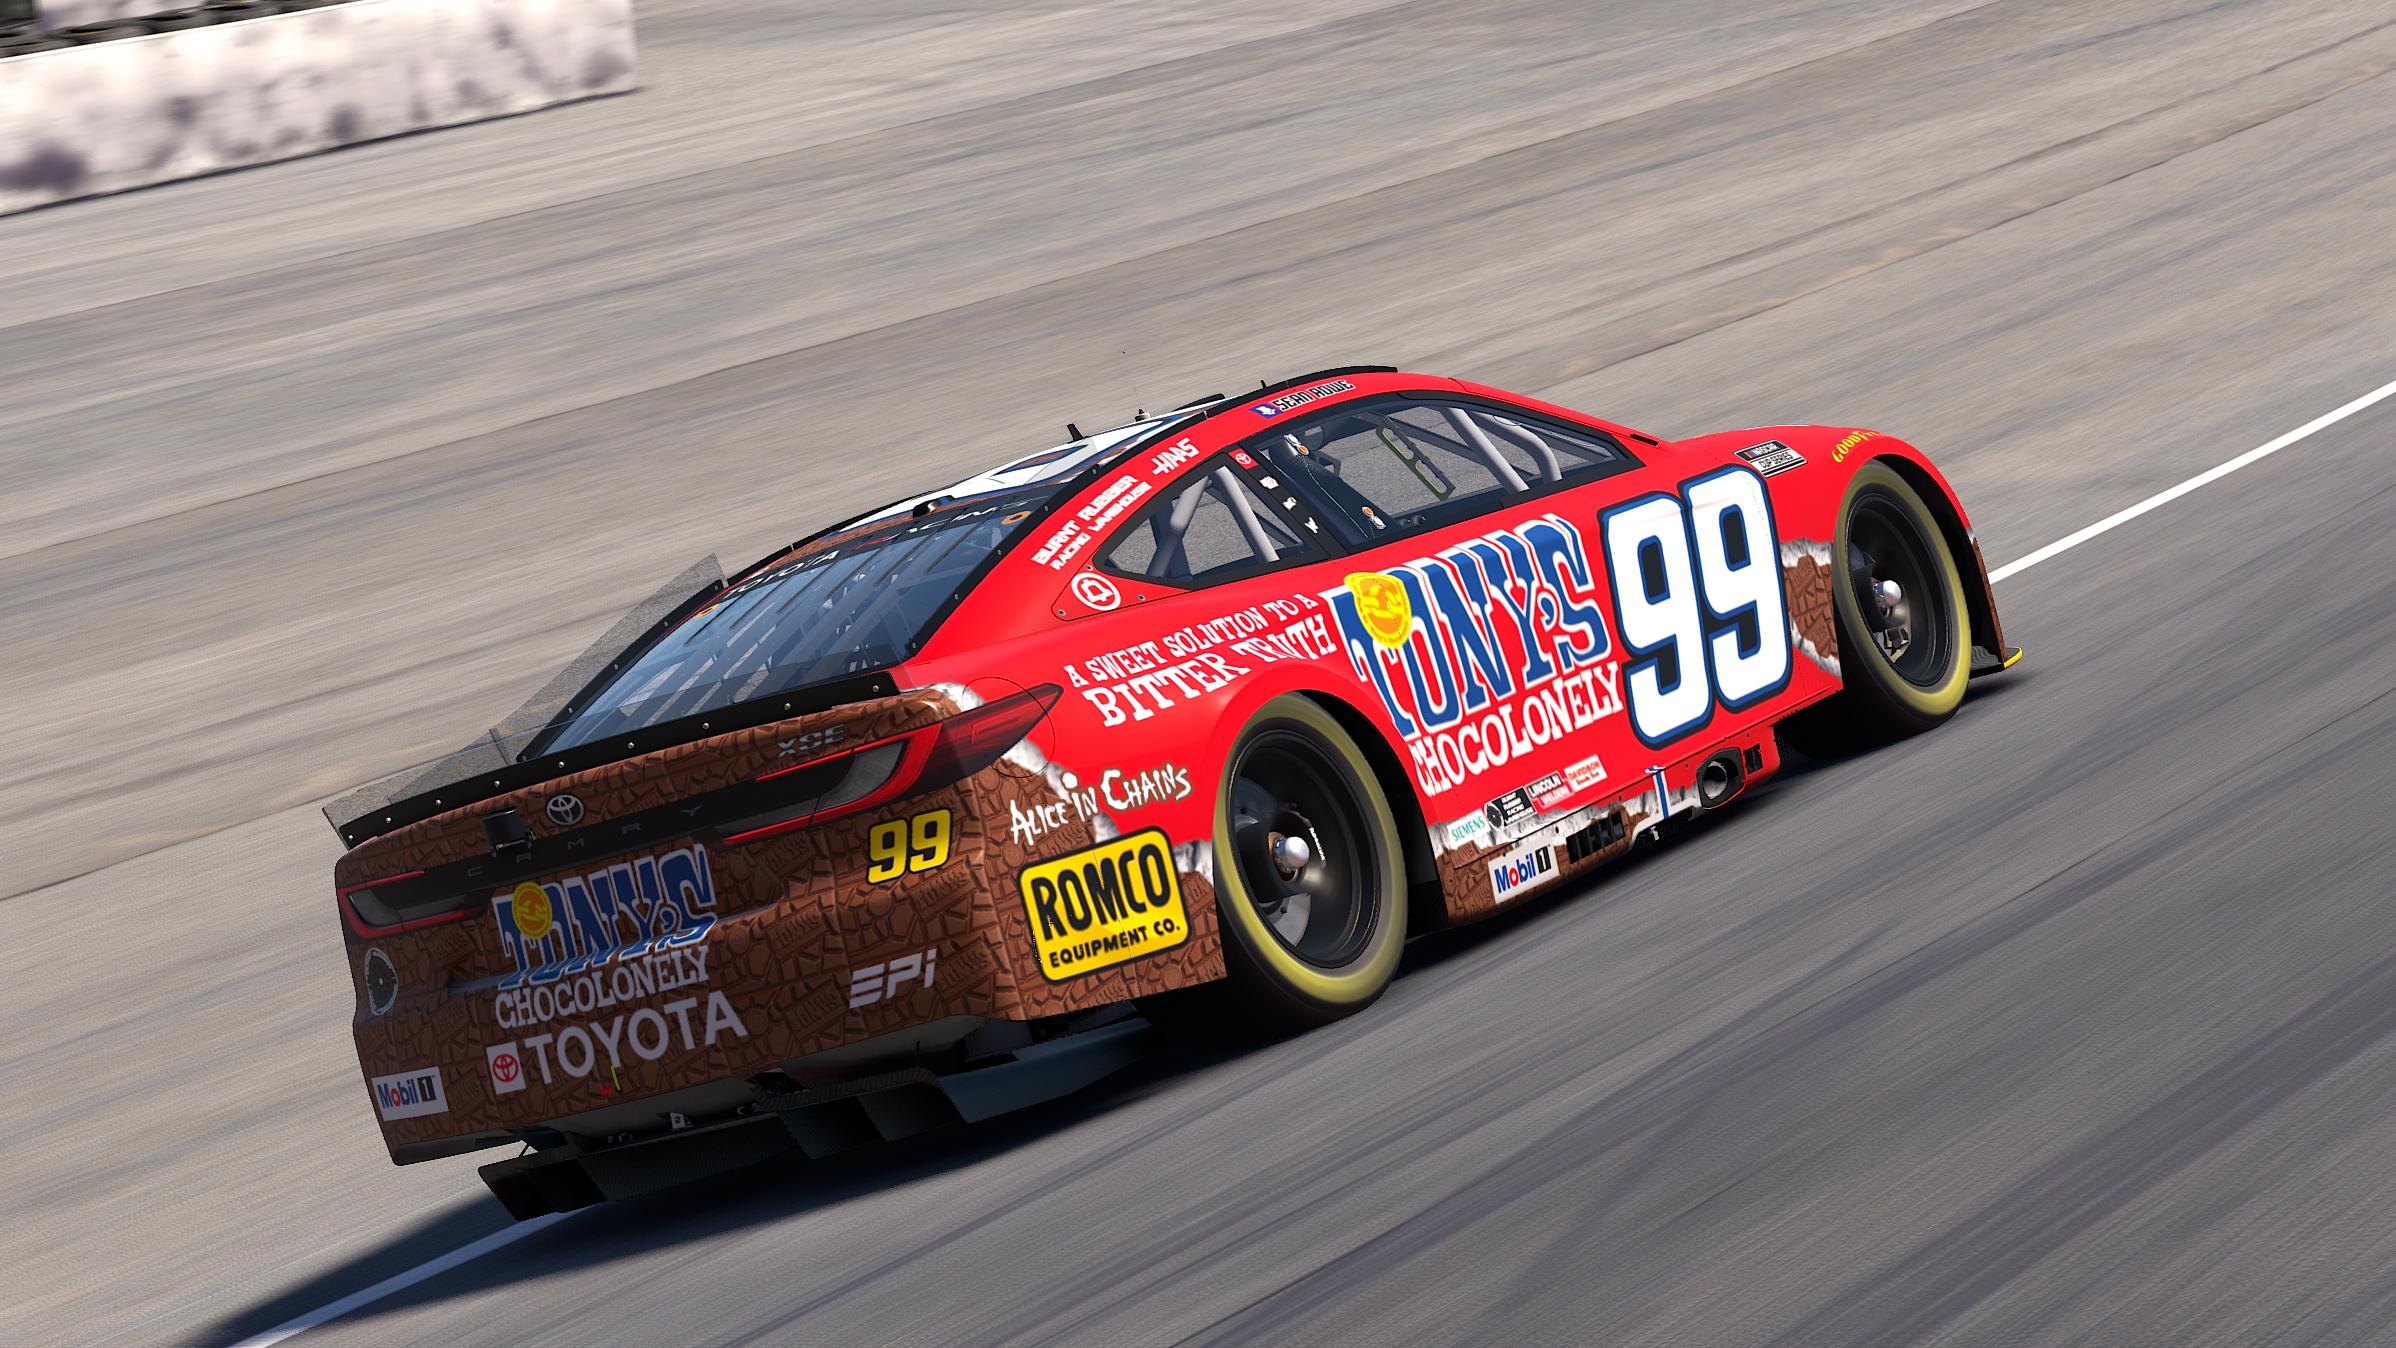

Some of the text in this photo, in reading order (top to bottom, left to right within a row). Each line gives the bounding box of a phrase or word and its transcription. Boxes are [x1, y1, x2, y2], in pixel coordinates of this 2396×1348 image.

[1271, 391, 1314, 411] SEAN
[1151, 438, 1199, 475] HAAS
[1759, 452, 1793, 468] CUP SERIES
[1031, 520, 1081, 565] BURNT
[1076, 475, 1138, 521] RUBBER
[1050, 532, 1092, 571] RACING
[1088, 481, 1152, 532] WAREHOUSE
[1064, 594, 1318, 688] A SWEET SOLUTION TO A
[1321, 513, 1612, 741] TONY'S
[1600, 464, 1792, 748] 99
[1082, 613, 1337, 727] BITTER TRUTH
[777, 724, 847, 758] XSE
[1407, 661, 1624, 798] CHOCOLONELY
[1528, 774, 1562, 798] LINCOLN
[867, 807, 952, 885] 99
[1452, 815, 1486, 842] SIEMENS
[1030, 843, 1171, 941] ROMCO
[1494, 853, 1537, 894] Mobil
[492, 843, 718, 990] TONY'S
[1048, 917, 1181, 968] EQUIPMENT CO.
[495, 946, 709, 1029] CHOCOLONELY
[524, 990, 748, 1085] TOYOTA
[377, 1078, 420, 1109] Mobil
